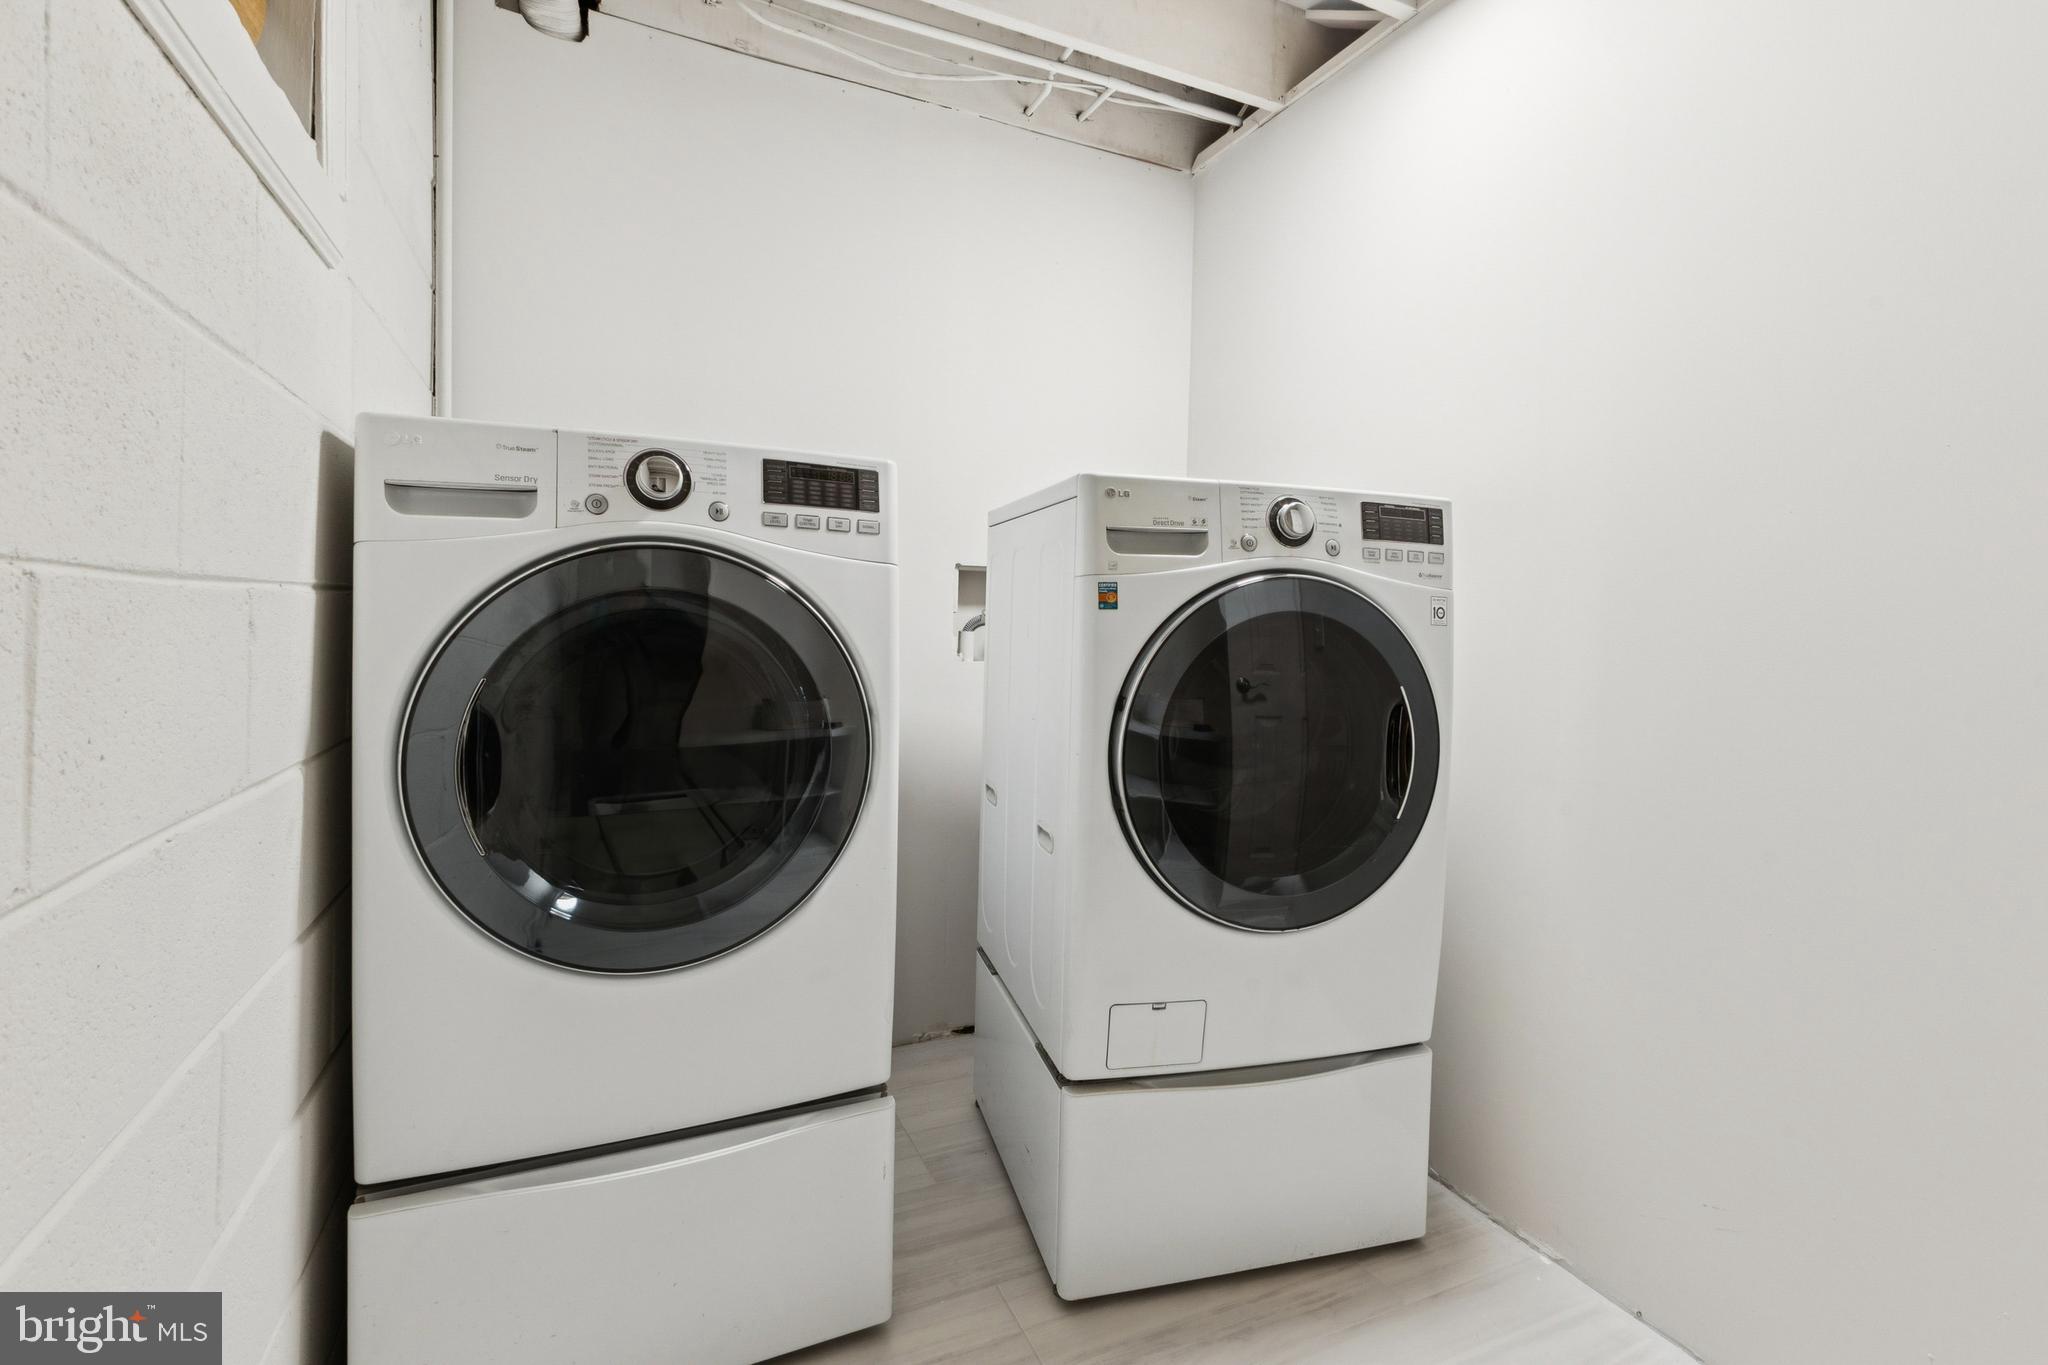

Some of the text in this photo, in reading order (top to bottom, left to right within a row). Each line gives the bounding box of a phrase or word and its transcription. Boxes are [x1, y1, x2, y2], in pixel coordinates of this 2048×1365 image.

[494, 473, 538, 485] Sensor Dry
[1433, 606, 1446, 620] 10
